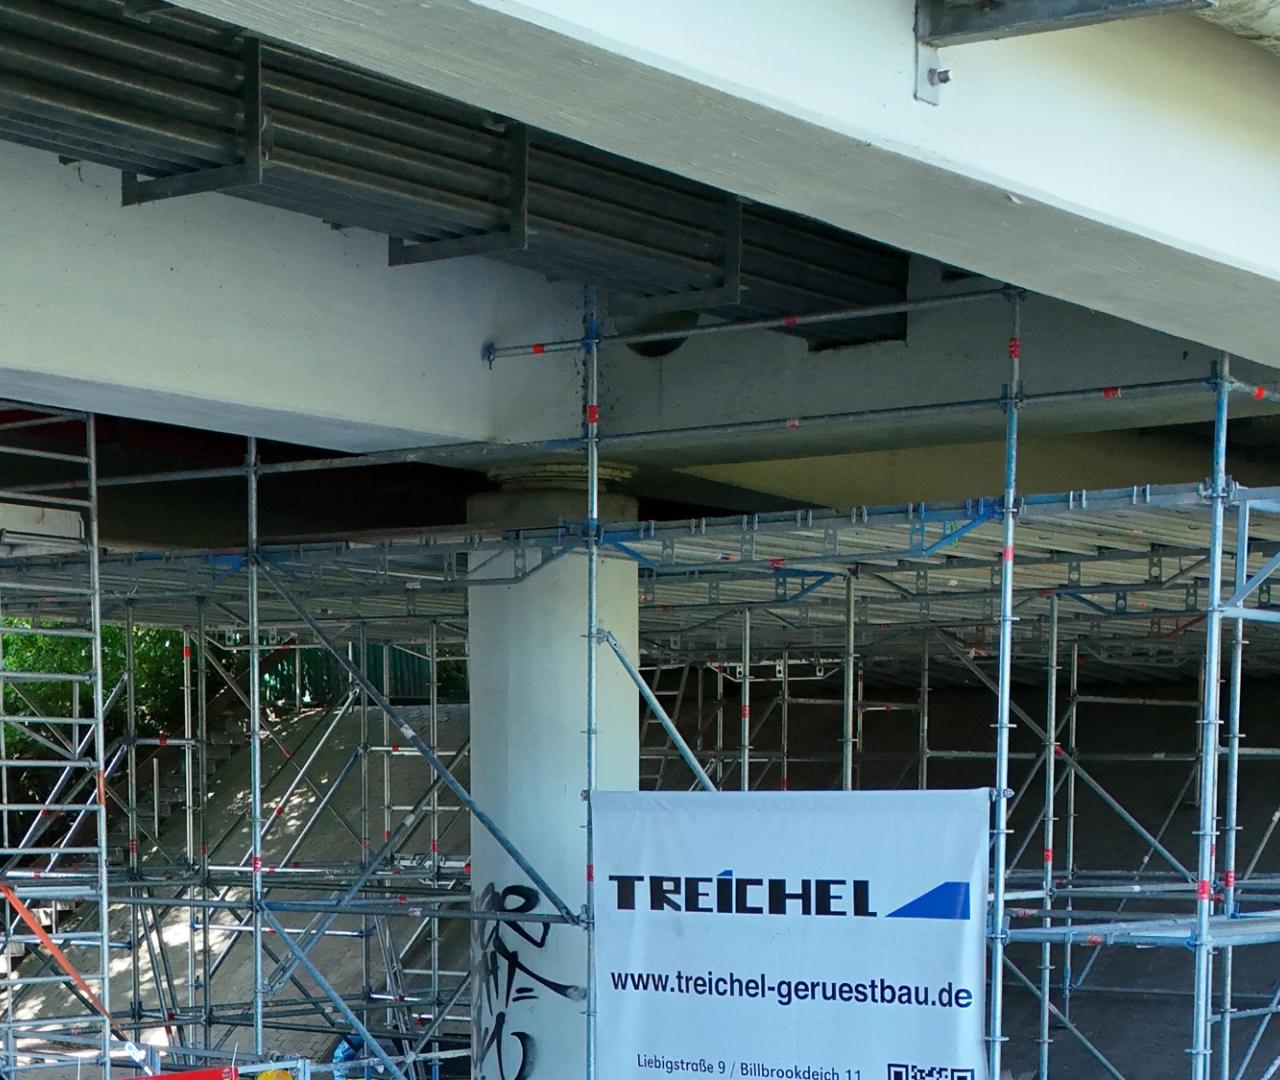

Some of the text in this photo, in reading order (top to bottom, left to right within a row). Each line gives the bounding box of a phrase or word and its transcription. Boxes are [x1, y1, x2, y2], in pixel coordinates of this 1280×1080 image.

[608, 869, 878, 918] TREICHEL
[610, 969, 974, 1009] www.treichel-geruestbau.de
[637, 1053, 714, 1074] Liebigstraße
[717, 1060, 726, 1075] 9
